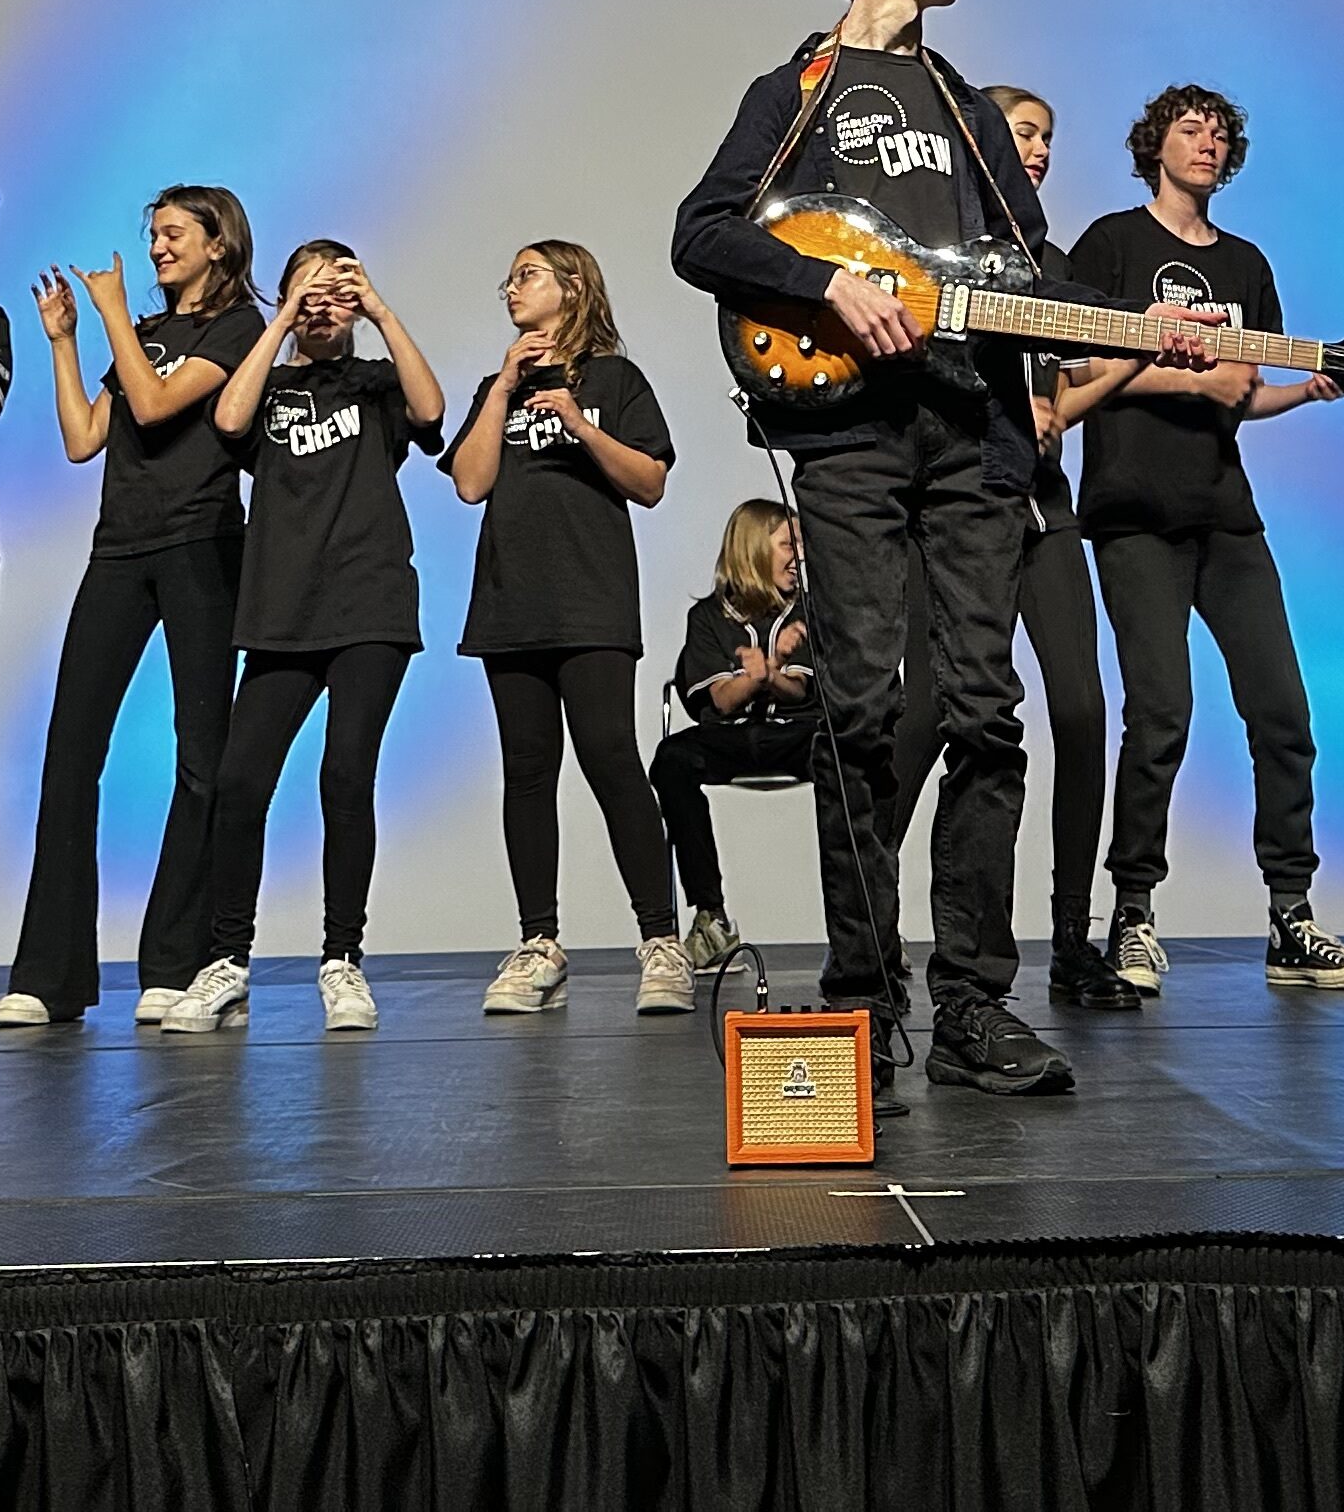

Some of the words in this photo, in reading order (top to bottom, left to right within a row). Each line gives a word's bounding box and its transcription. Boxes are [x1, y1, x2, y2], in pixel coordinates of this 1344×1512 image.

[836, 113, 894, 133] FABULOUS
[837, 124, 884, 141] VARIETY
[838, 134, 874, 151] SHOW
[876, 130, 953, 178] CREW
[289, 404, 361, 457] CREW
